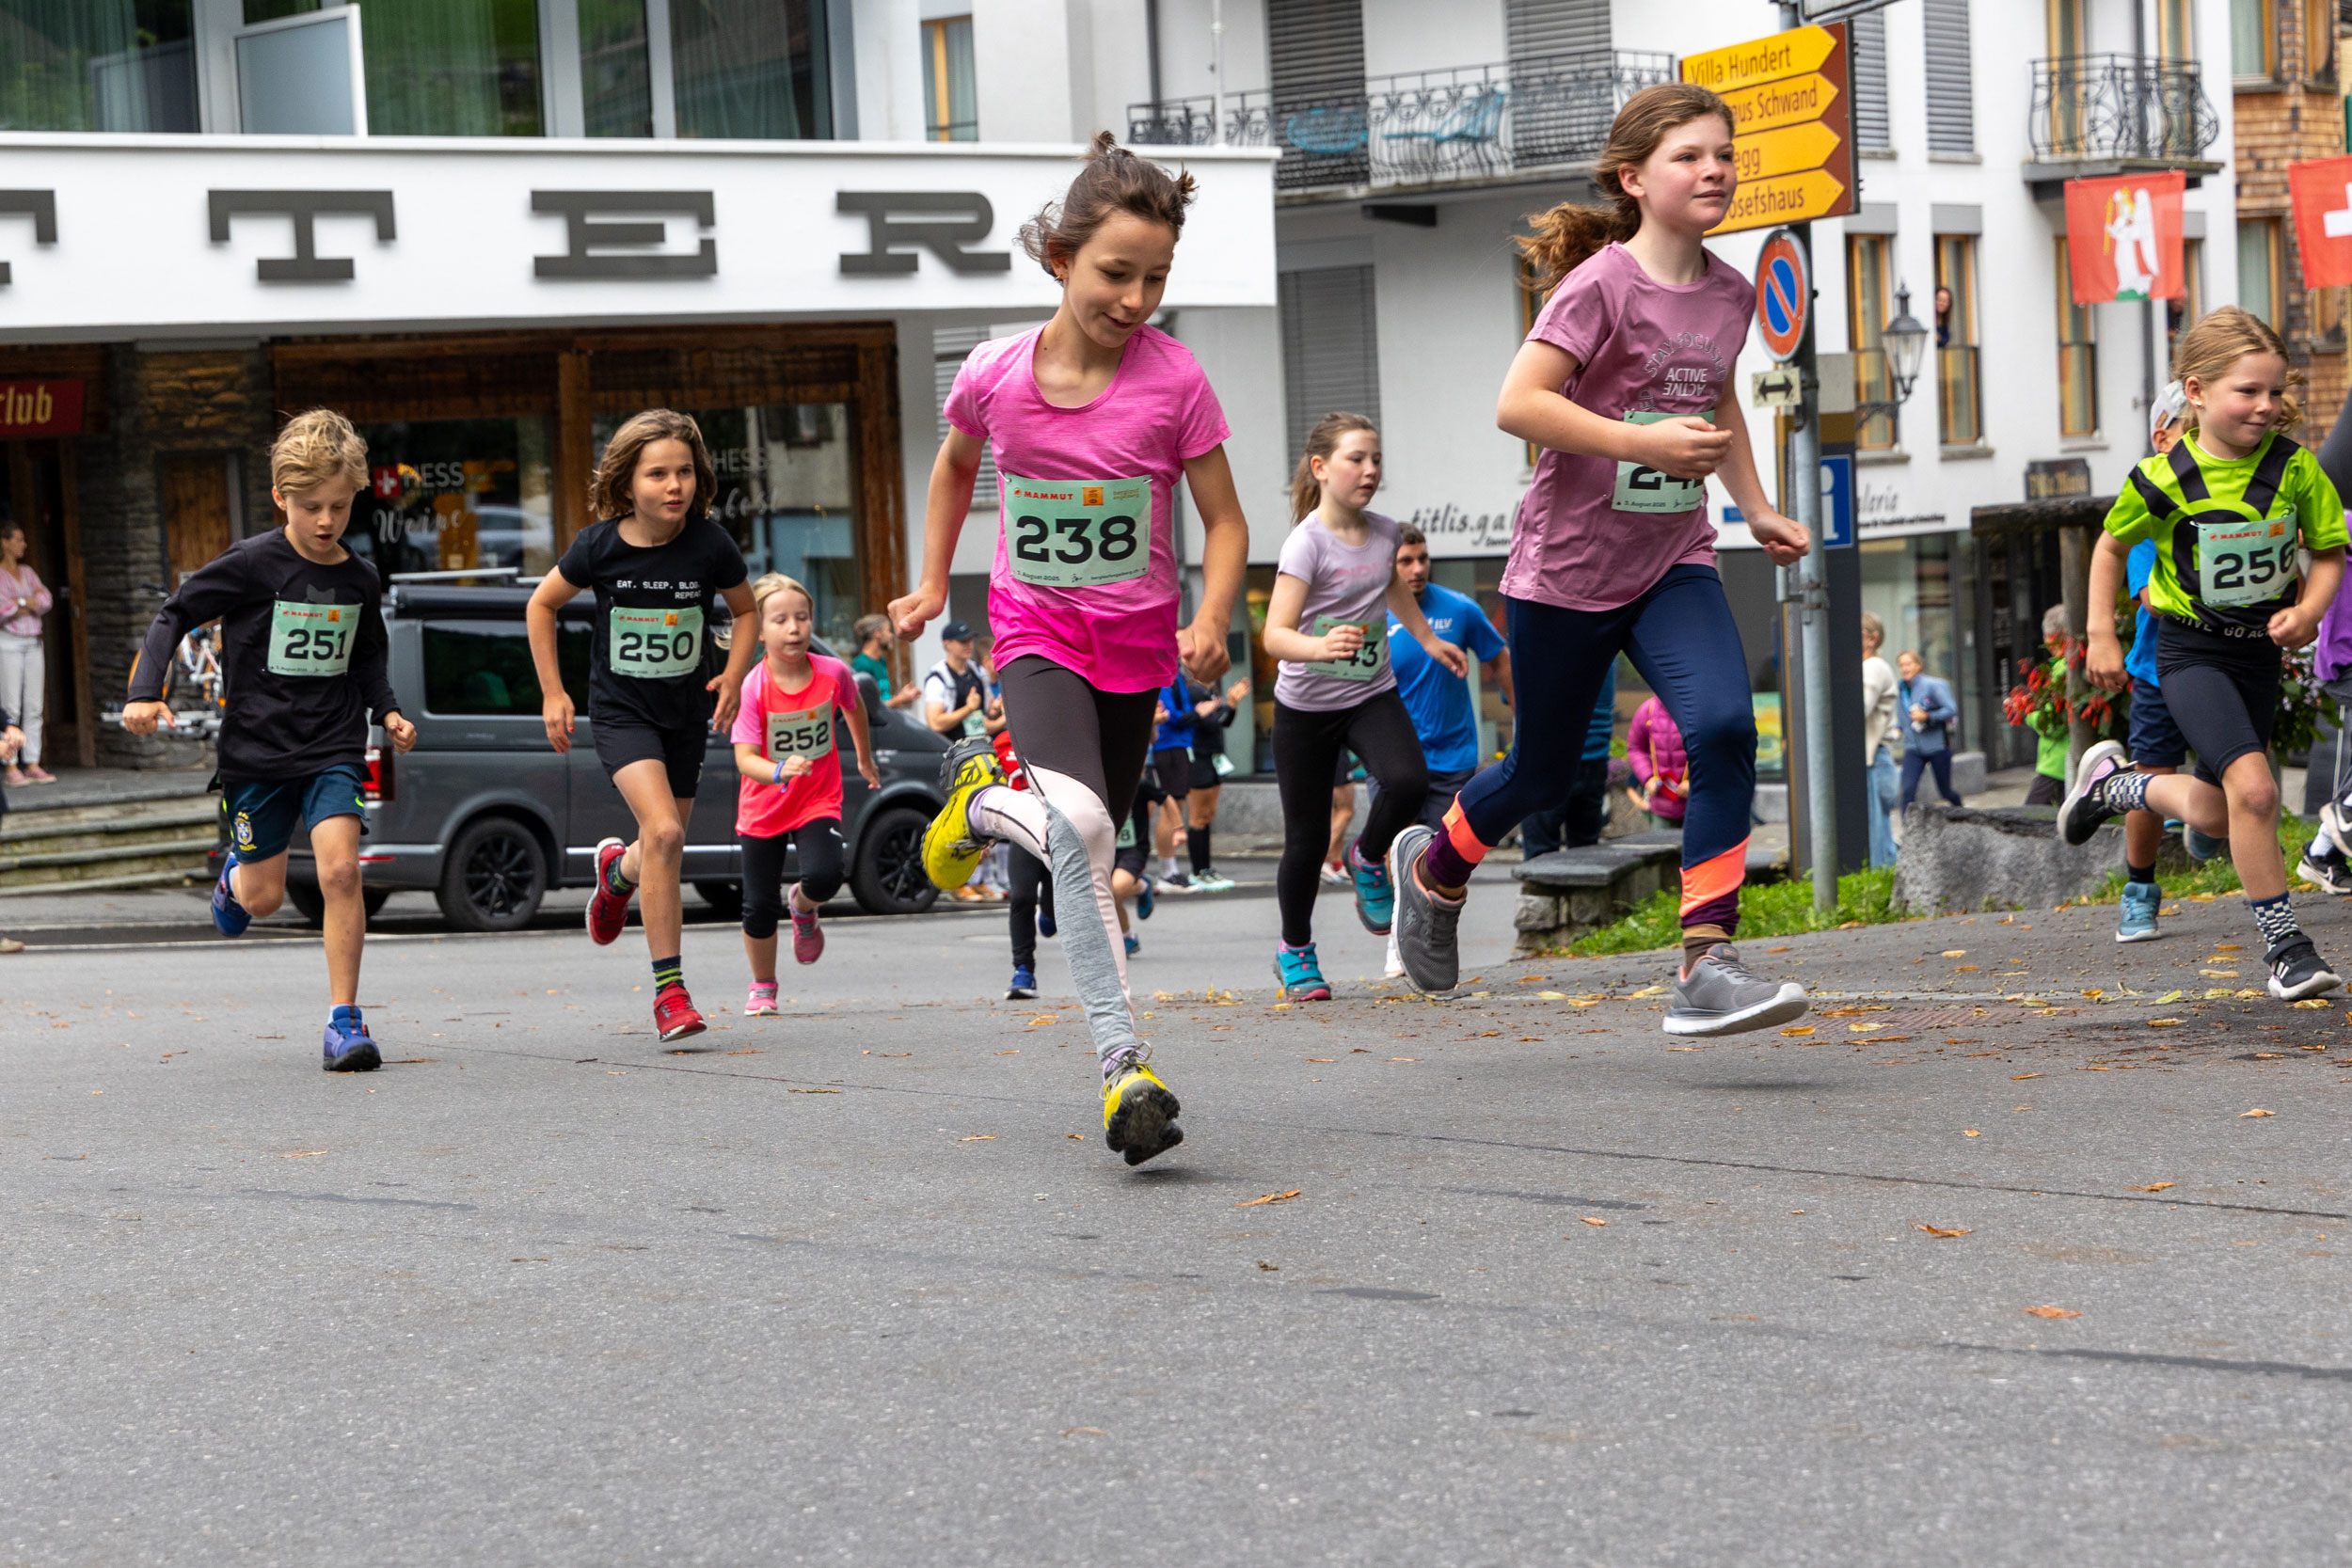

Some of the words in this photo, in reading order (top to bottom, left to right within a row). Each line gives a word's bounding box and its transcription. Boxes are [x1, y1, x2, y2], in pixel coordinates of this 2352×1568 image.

[1691, 59, 1724, 86] Villa
[1729, 44, 1791, 79] Hundert
[1757, 79, 1818, 119] Schwand
[1734, 147, 1760, 177] egg
[1727, 184, 1804, 220] osefshaus
[1643, 337, 1675, 378] STAY
[1664, 368, 1708, 383] ACTIVE
[0, 385, 54, 426] lub
[403, 461, 466, 488] HESS
[1024, 490, 1073, 501] MAMMUT
[1016, 515, 1137, 564] 238
[2219, 531, 2263, 540] MAMMUT
[2213, 537, 2296, 590] 256
[616, 579, 637, 589] EAT.
[643, 581, 674, 590] SLEEP.
[284, 628, 347, 660] 251
[619, 631, 694, 663] 250
[2223, 627, 2245, 639] GO
[1329, 641, 1378, 668] 43
[774, 721, 829, 752] 252
